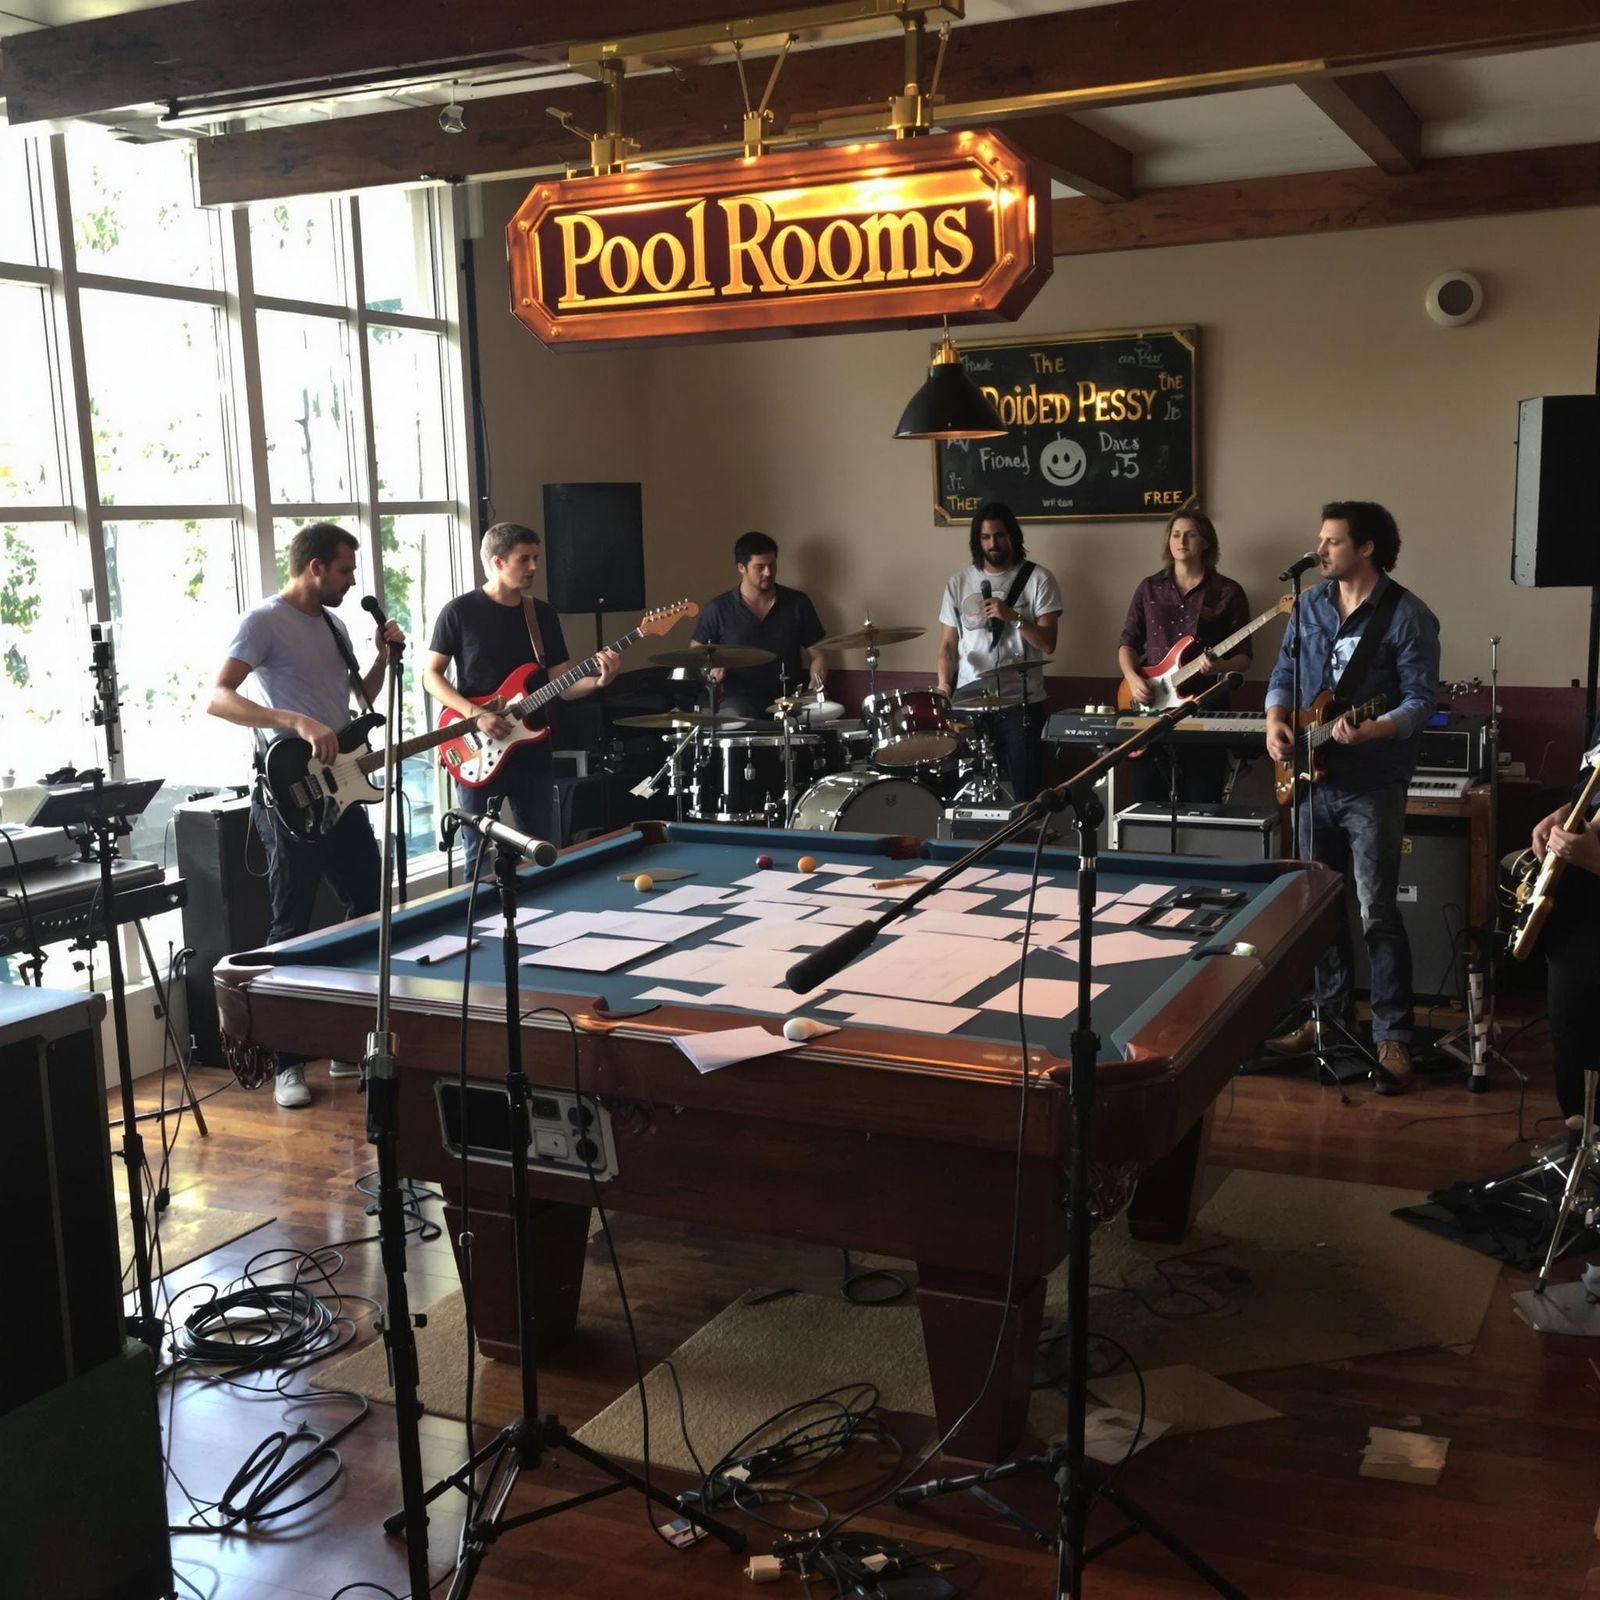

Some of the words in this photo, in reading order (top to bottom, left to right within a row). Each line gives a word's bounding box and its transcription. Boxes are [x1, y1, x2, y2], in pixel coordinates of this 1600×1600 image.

[554, 198, 715, 303] Pool
[718, 196, 975, 295] Rooms
[1076, 380, 1158, 424] PESSY
[1143, 489, 1184, 506] FREE
